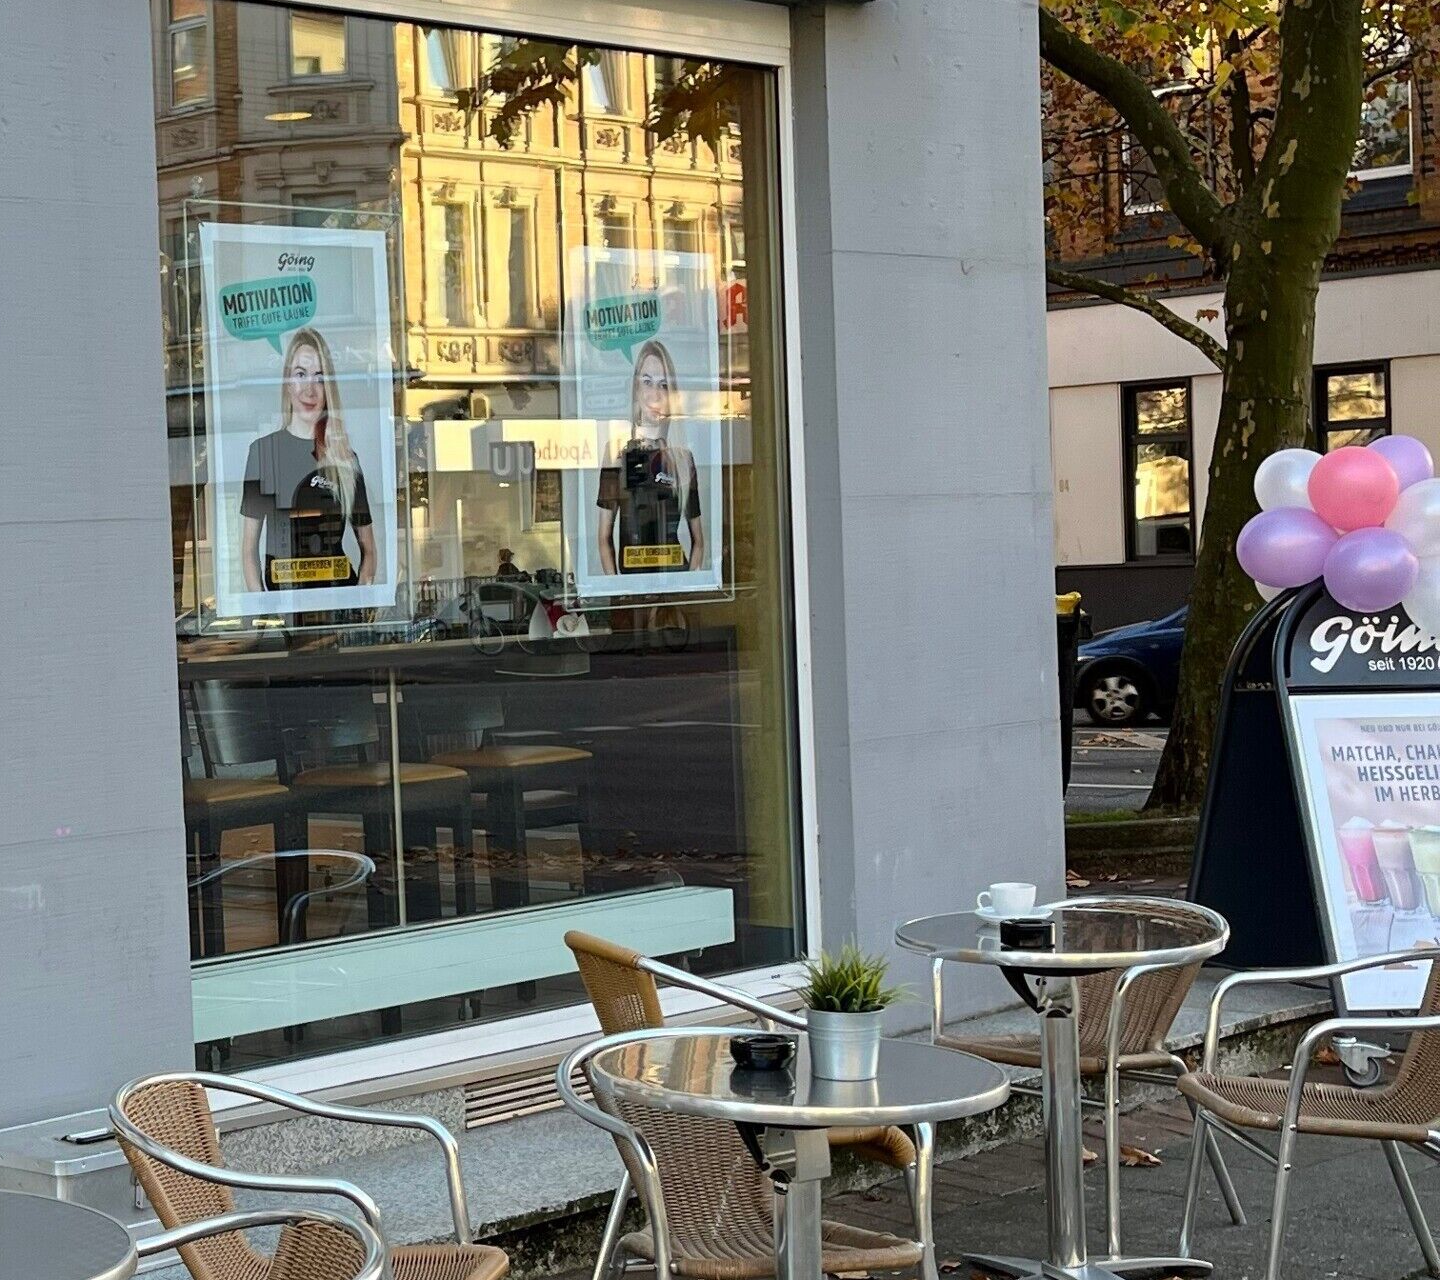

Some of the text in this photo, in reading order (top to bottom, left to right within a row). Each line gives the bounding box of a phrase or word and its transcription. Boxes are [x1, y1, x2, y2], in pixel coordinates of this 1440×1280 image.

[278, 253, 315, 272] Göing
[223, 282, 312, 315] MOTIVATION
[233, 306, 310, 329] TRIFFT GUTE LAUNE
[586, 300, 658, 330] MOTIVATION
[1310, 615, 1440, 673] Göin
[1368, 656, 1435, 671] seit 1920
[1331, 745, 1401, 763] MATCHA,
[1375, 786, 1394, 802] IM
